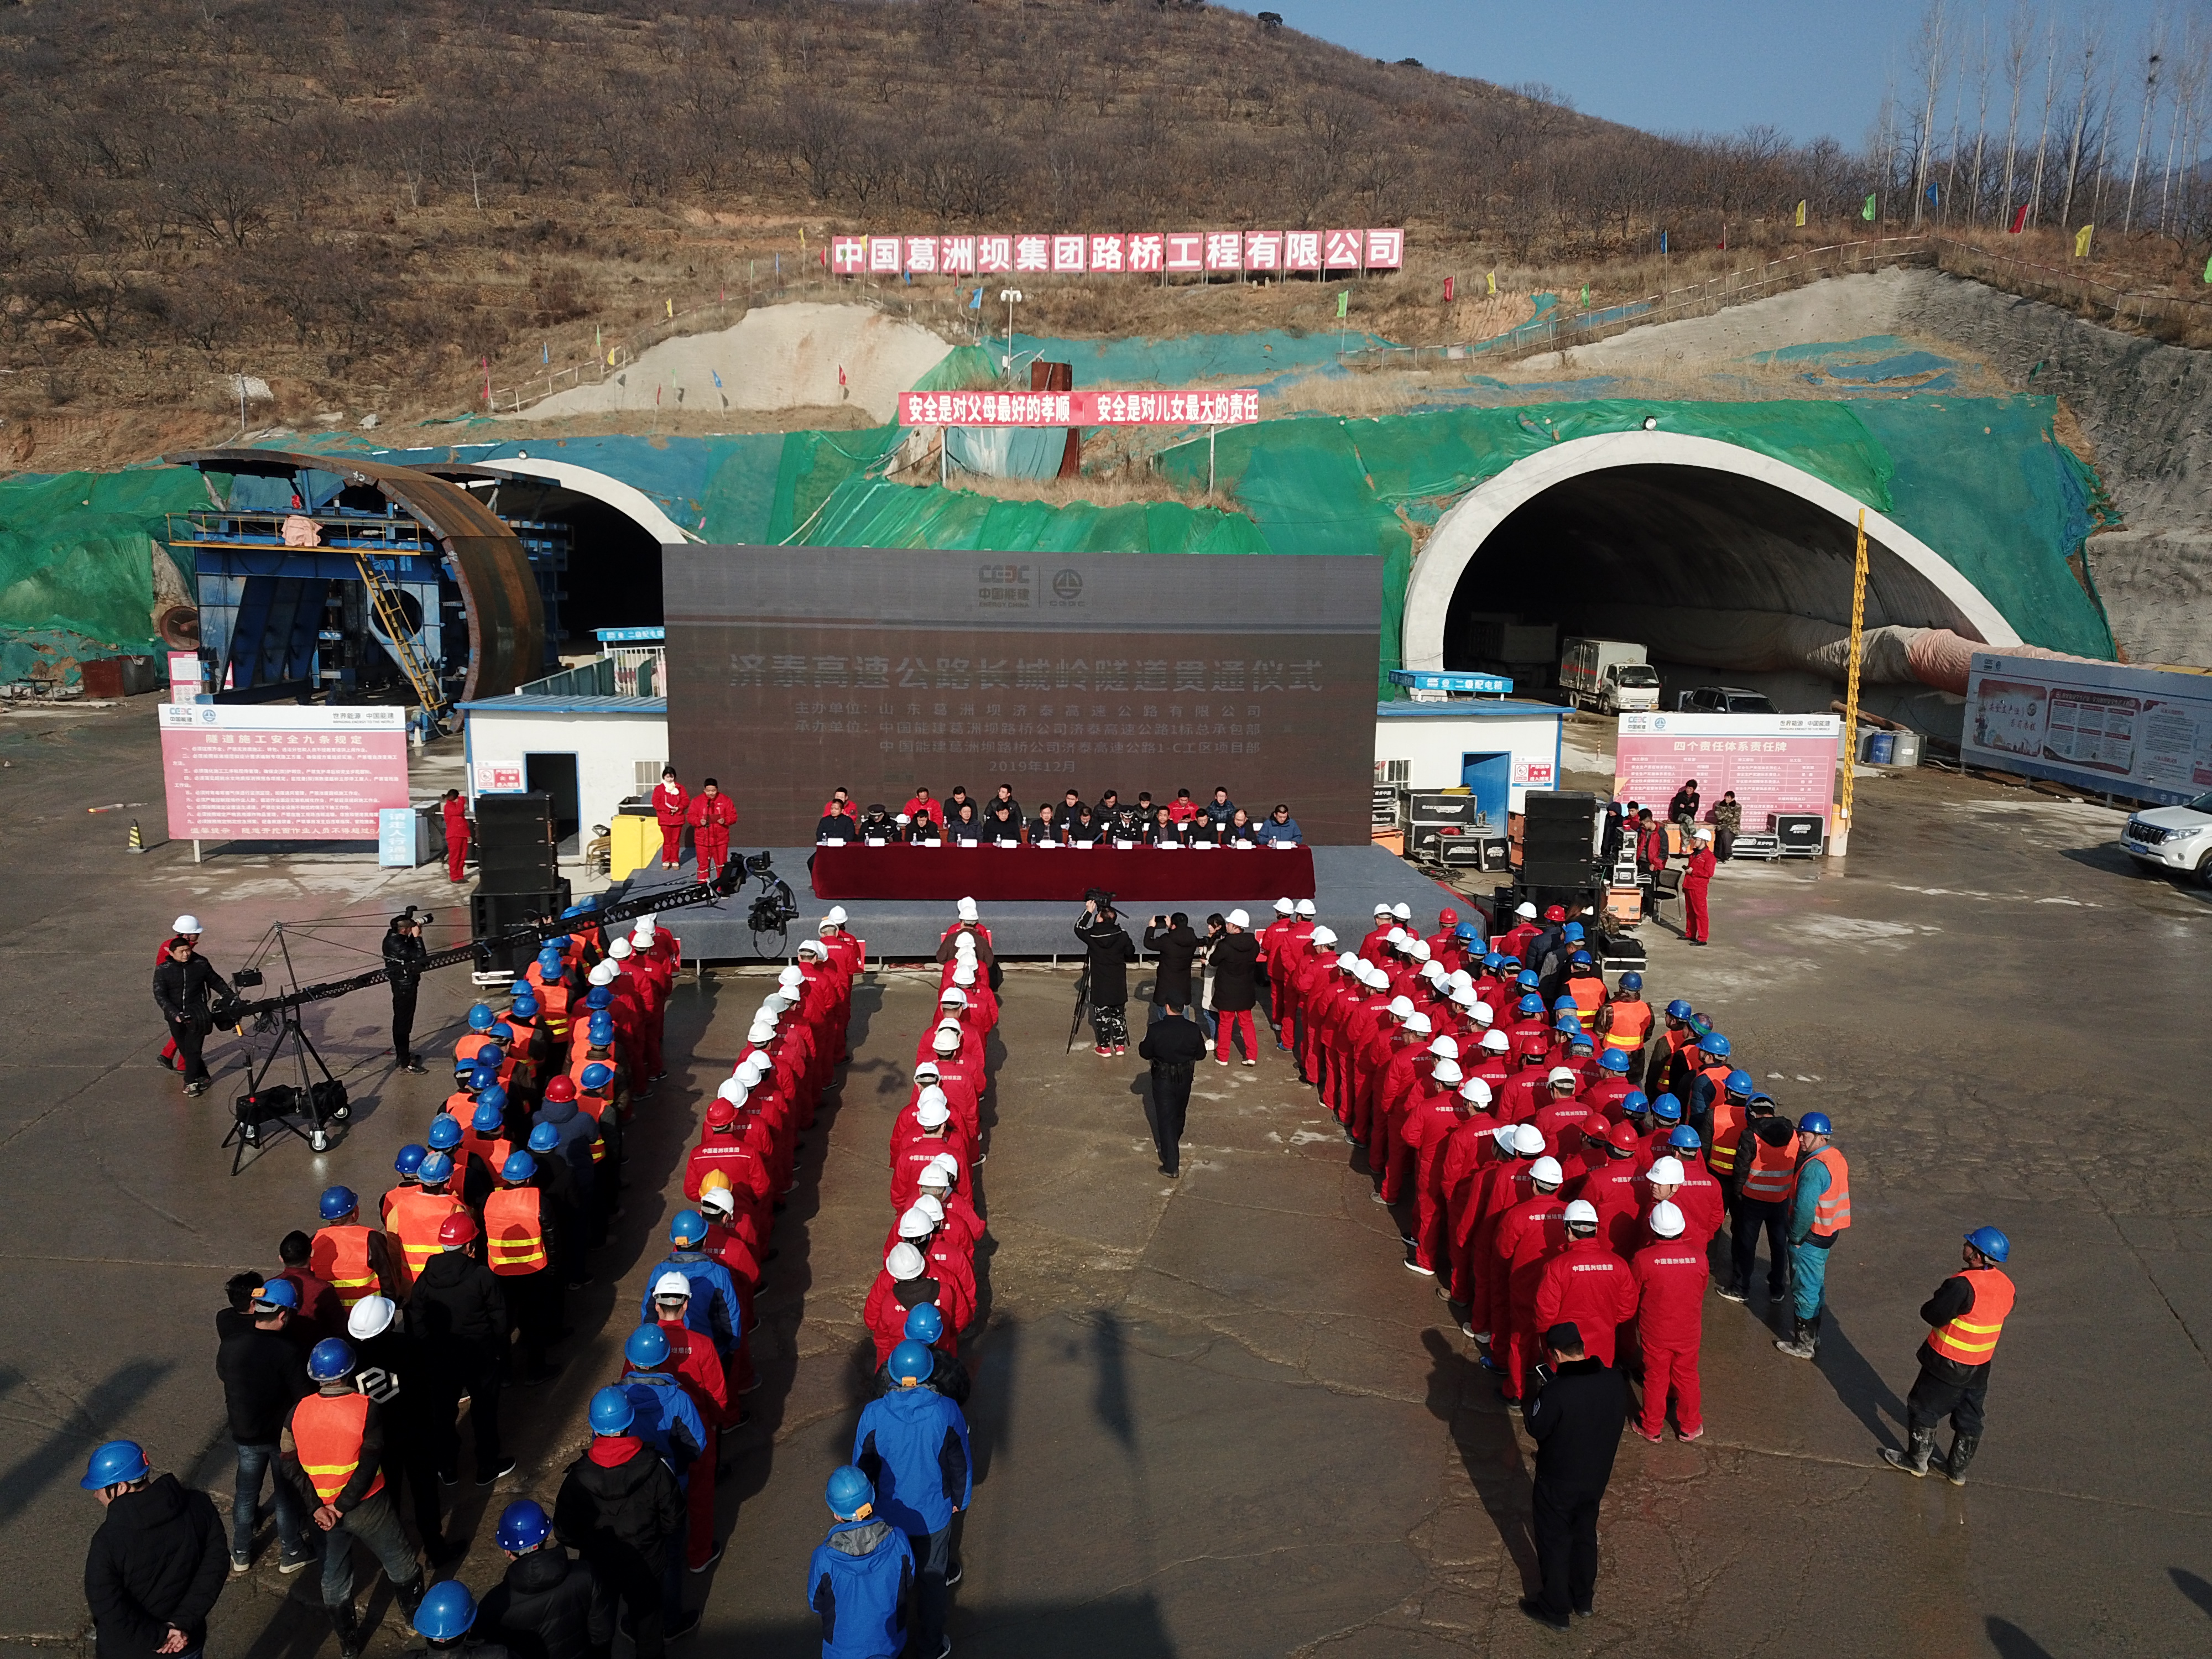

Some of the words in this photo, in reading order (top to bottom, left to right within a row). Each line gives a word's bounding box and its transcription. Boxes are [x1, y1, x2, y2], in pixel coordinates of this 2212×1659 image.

[836, 229, 1402, 272] 中国葛洲坝集团路桥工程有限公司
[909, 394, 1071, 423] 安全是对父母最好的孝顺
[1097, 393, 1259, 422] 安全是对儿女最大的责任
[978, 587, 1030, 601] 中国能建
[729, 653, 1323, 693] 济泰高速公路长城岭隧道贯通仪式
[1455, 680, 1503, 690] 二级配电箱
[205, 734, 363, 744] 隧道施工安全九条规定
[1673, 741, 1788, 753] 四个责任体系责任牌
[989, 760, 1076, 773] 2019年12月
[388, 813, 406, 861] 请走人行通道
[1654, 1257, 1697, 1265] 中国葛洲坝集团
[1572, 1264, 1613, 1272] 中国葛洲坝集团
